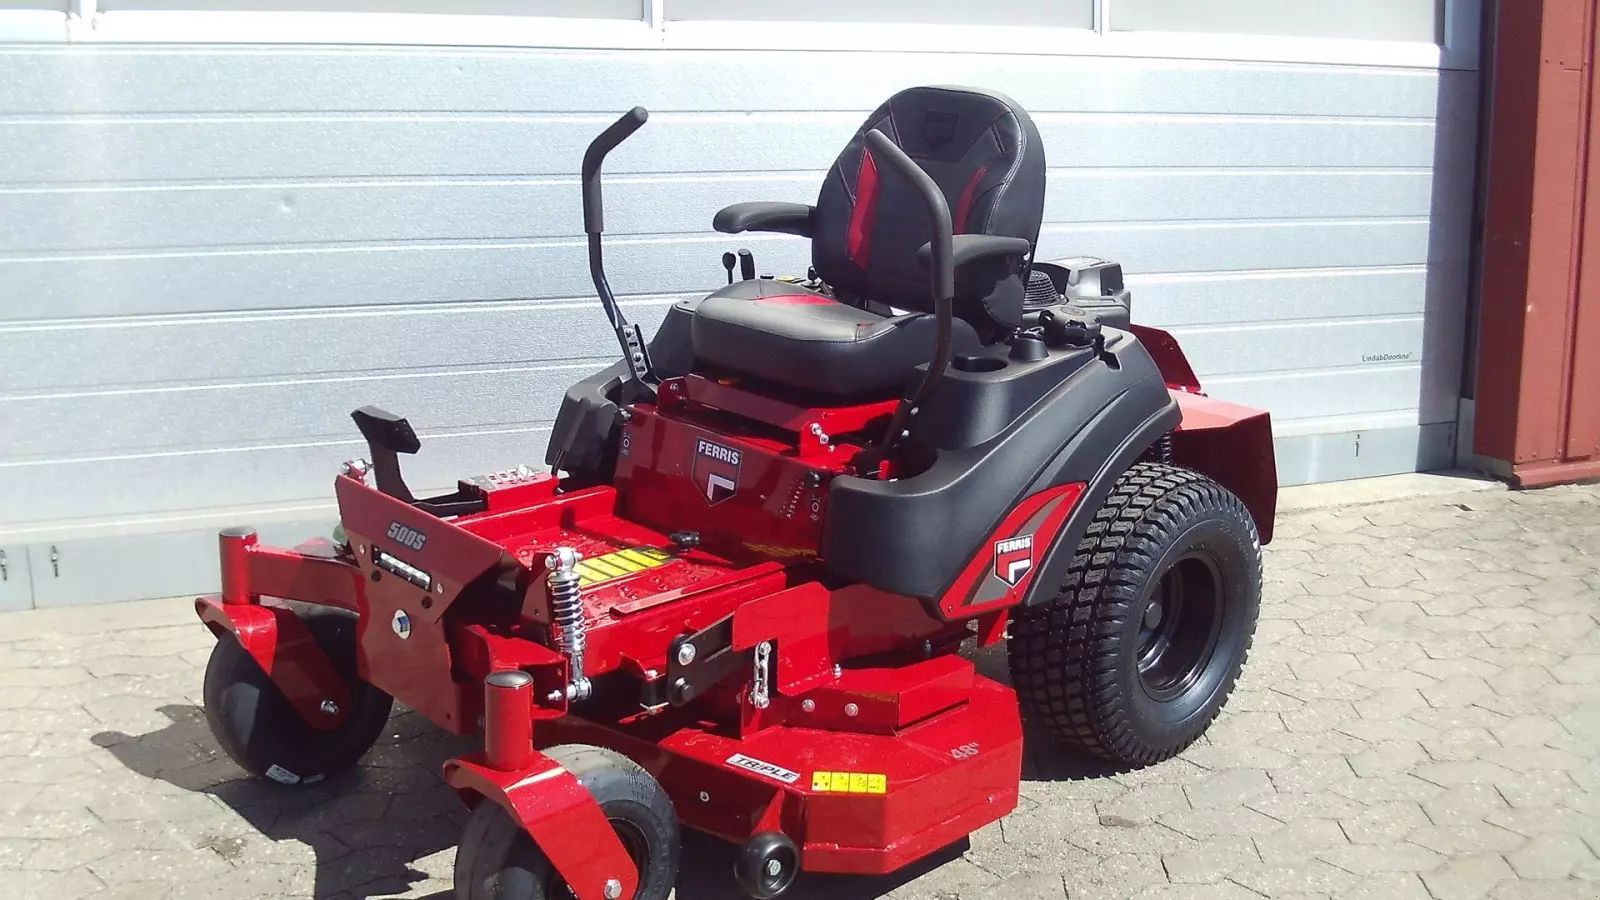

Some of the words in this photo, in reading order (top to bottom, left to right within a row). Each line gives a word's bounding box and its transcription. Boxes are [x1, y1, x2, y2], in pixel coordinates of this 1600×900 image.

[698, 440, 740, 465] FERRIS
[387, 521, 427, 550] 500S
[997, 537, 1032, 555] FERRIS
[736, 757, 797, 780] TRIPLE
